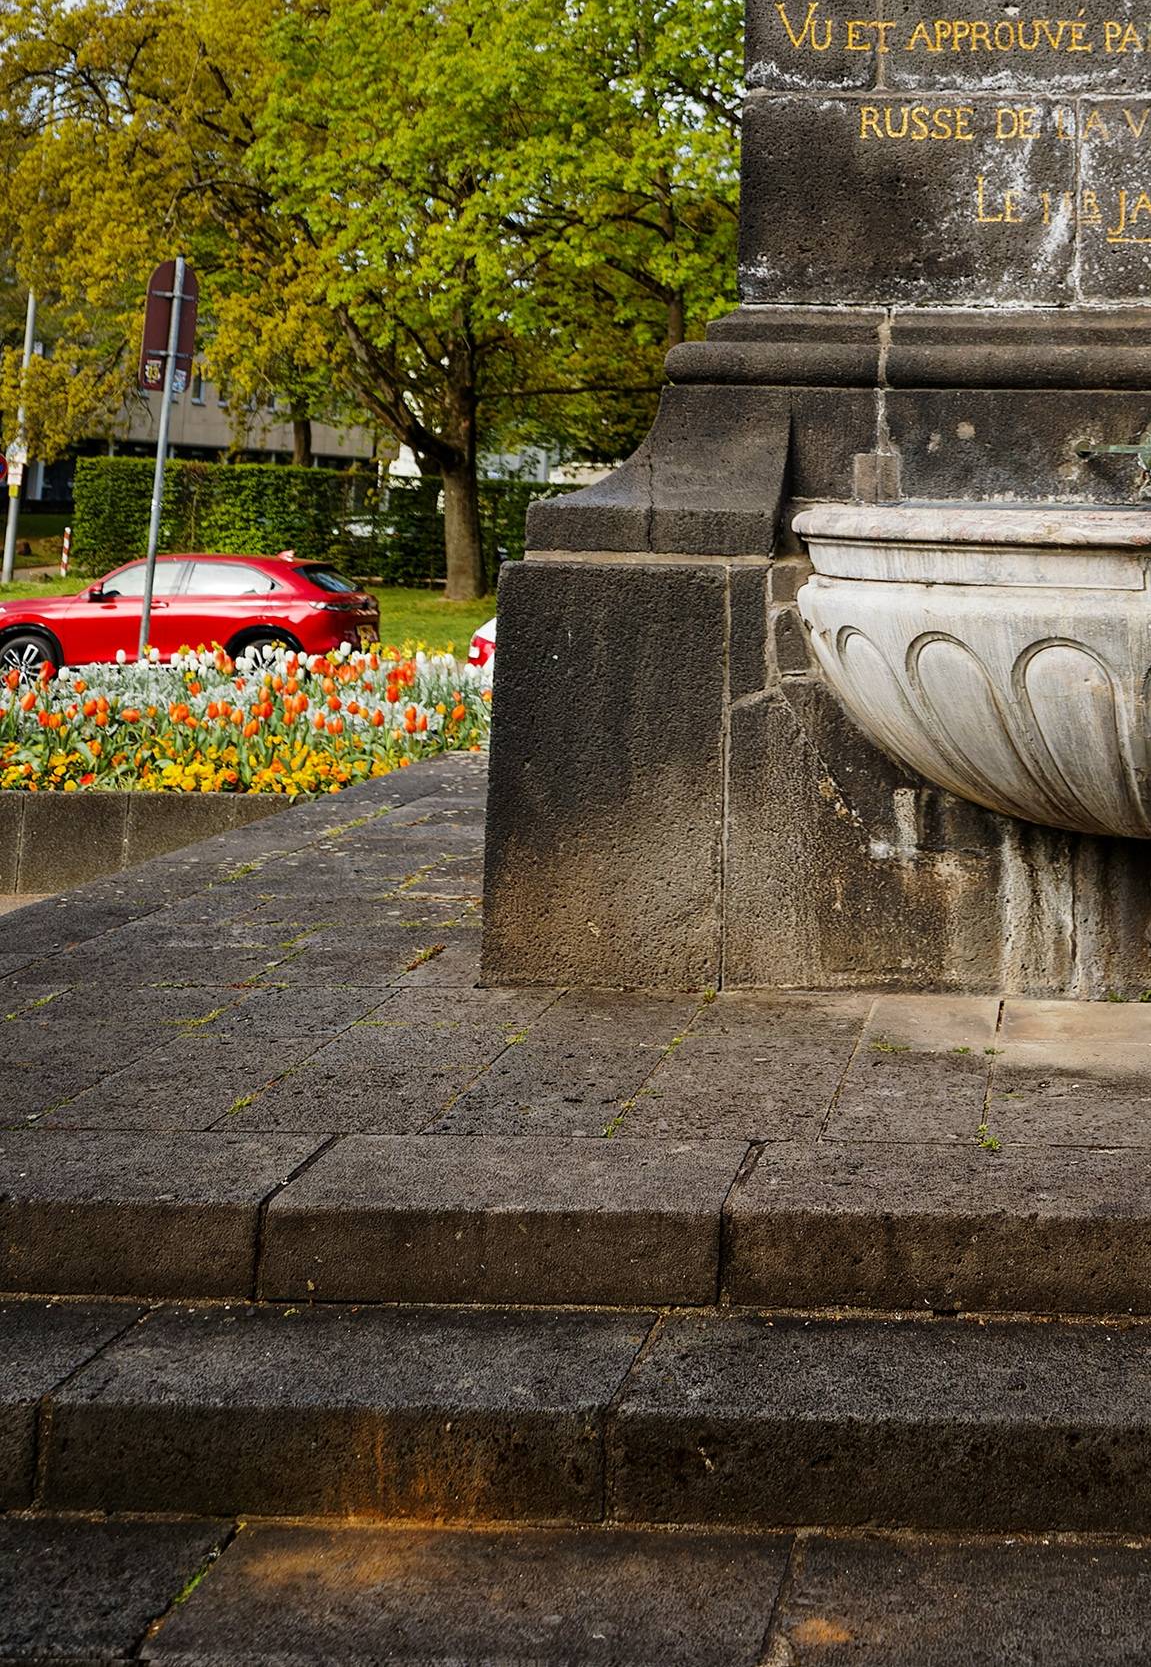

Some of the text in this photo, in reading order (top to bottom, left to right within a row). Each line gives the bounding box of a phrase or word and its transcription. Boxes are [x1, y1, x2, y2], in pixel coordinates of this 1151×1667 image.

[775, 1, 832, 51] VU
[844, 20, 896, 53] ET
[904, 8, 1092, 53] APPROUVÉ
[860, 106, 976, 141] RUSSE
[996, 107, 1041, 140] DE
[1056, 107, 1110, 141] LA
[976, 174, 1024, 223] LE
